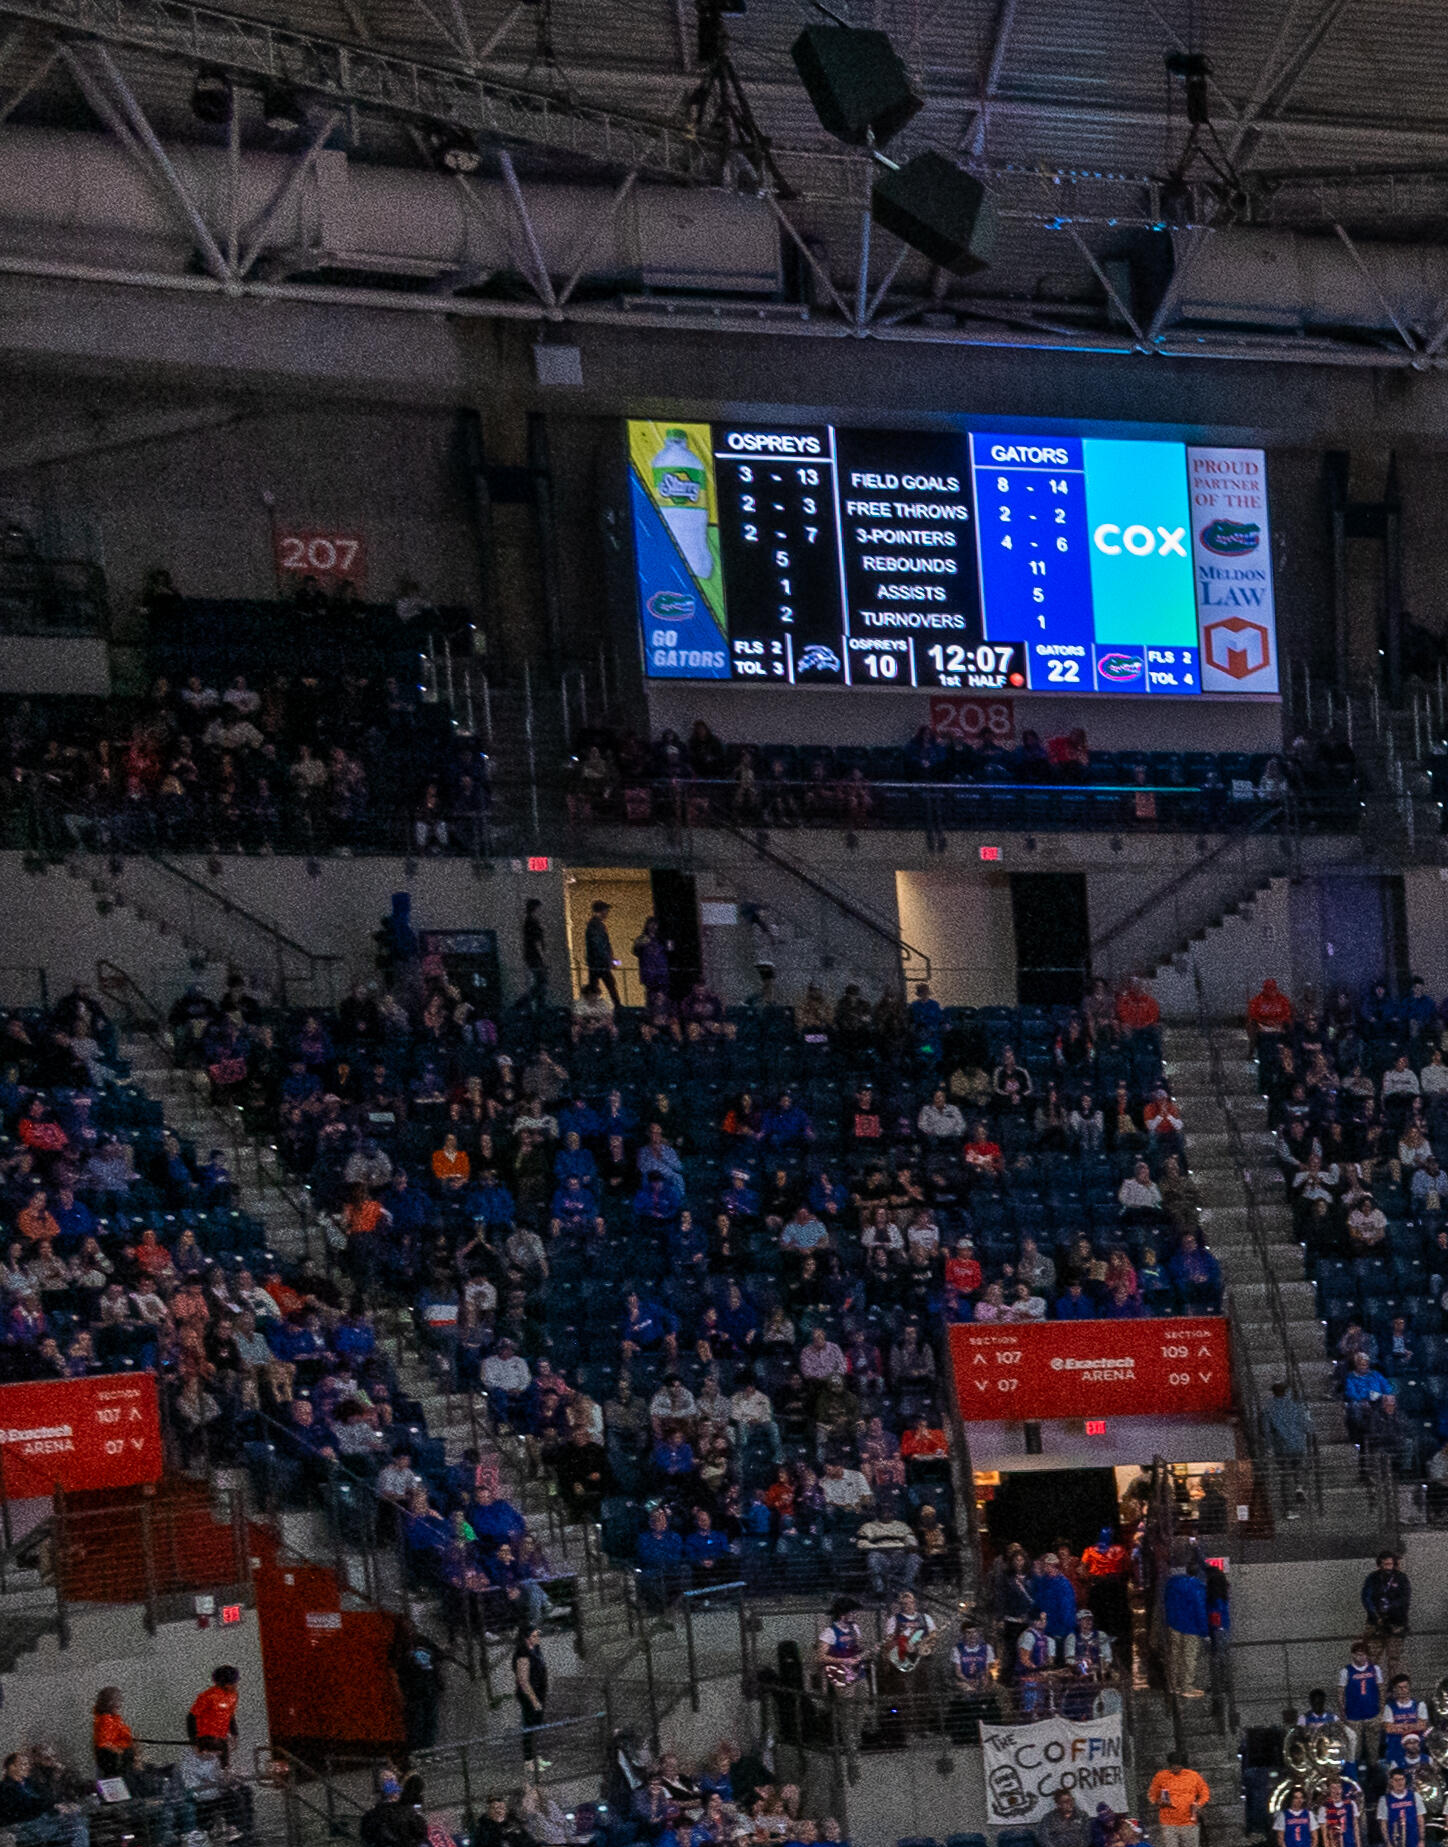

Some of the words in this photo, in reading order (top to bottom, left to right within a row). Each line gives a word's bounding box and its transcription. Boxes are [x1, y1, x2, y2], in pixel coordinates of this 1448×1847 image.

[728, 433, 820, 453] OSPREYS
[991, 446, 1068, 465] GATORS
[1193, 459, 1258, 475] PROUD
[851, 473, 898, 490] FIELD
[901, 474, 960, 491] GOALS
[1194, 477, 1260, 491] PARTNER
[1195, 493, 1220, 507] OF
[1224, 494, 1261, 508] THE
[847, 501, 892, 518] FREE
[894, 502, 968, 520] THROWS
[856, 528, 956, 546] 3-POINTERS
[1094, 523, 1187, 557] COX
[281, 537, 359, 570] 207
[863, 556, 957, 574] REBOUNDS
[877, 584, 947, 601] ASSISTS
[1200, 581, 1265, 606] LAW
[861, 611, 966, 629] TURNOVERS
[652, 630, 678, 647] GO
[849, 638, 908, 652] OSPREYS
[654, 650, 725, 668] GATORS
[928, 645, 1014, 673] 12:07
[1036, 644, 1085, 657] GATORS
[865, 655, 897, 679] 10
[1047, 661, 1080, 683] 22
[939, 674, 964, 687] 1st
[969, 674, 1006, 687] HALF
[935, 703, 1010, 735] 208
[996, 1351, 1021, 1364] 107
[1162, 1346, 1188, 1358] 109
[1082, 1370, 1136, 1381] ARENA
[985, 1734, 1017, 1752] THE
[1015, 1736, 1121, 1769] COFFIN
[1038, 1765, 1123, 1797] CORNER
